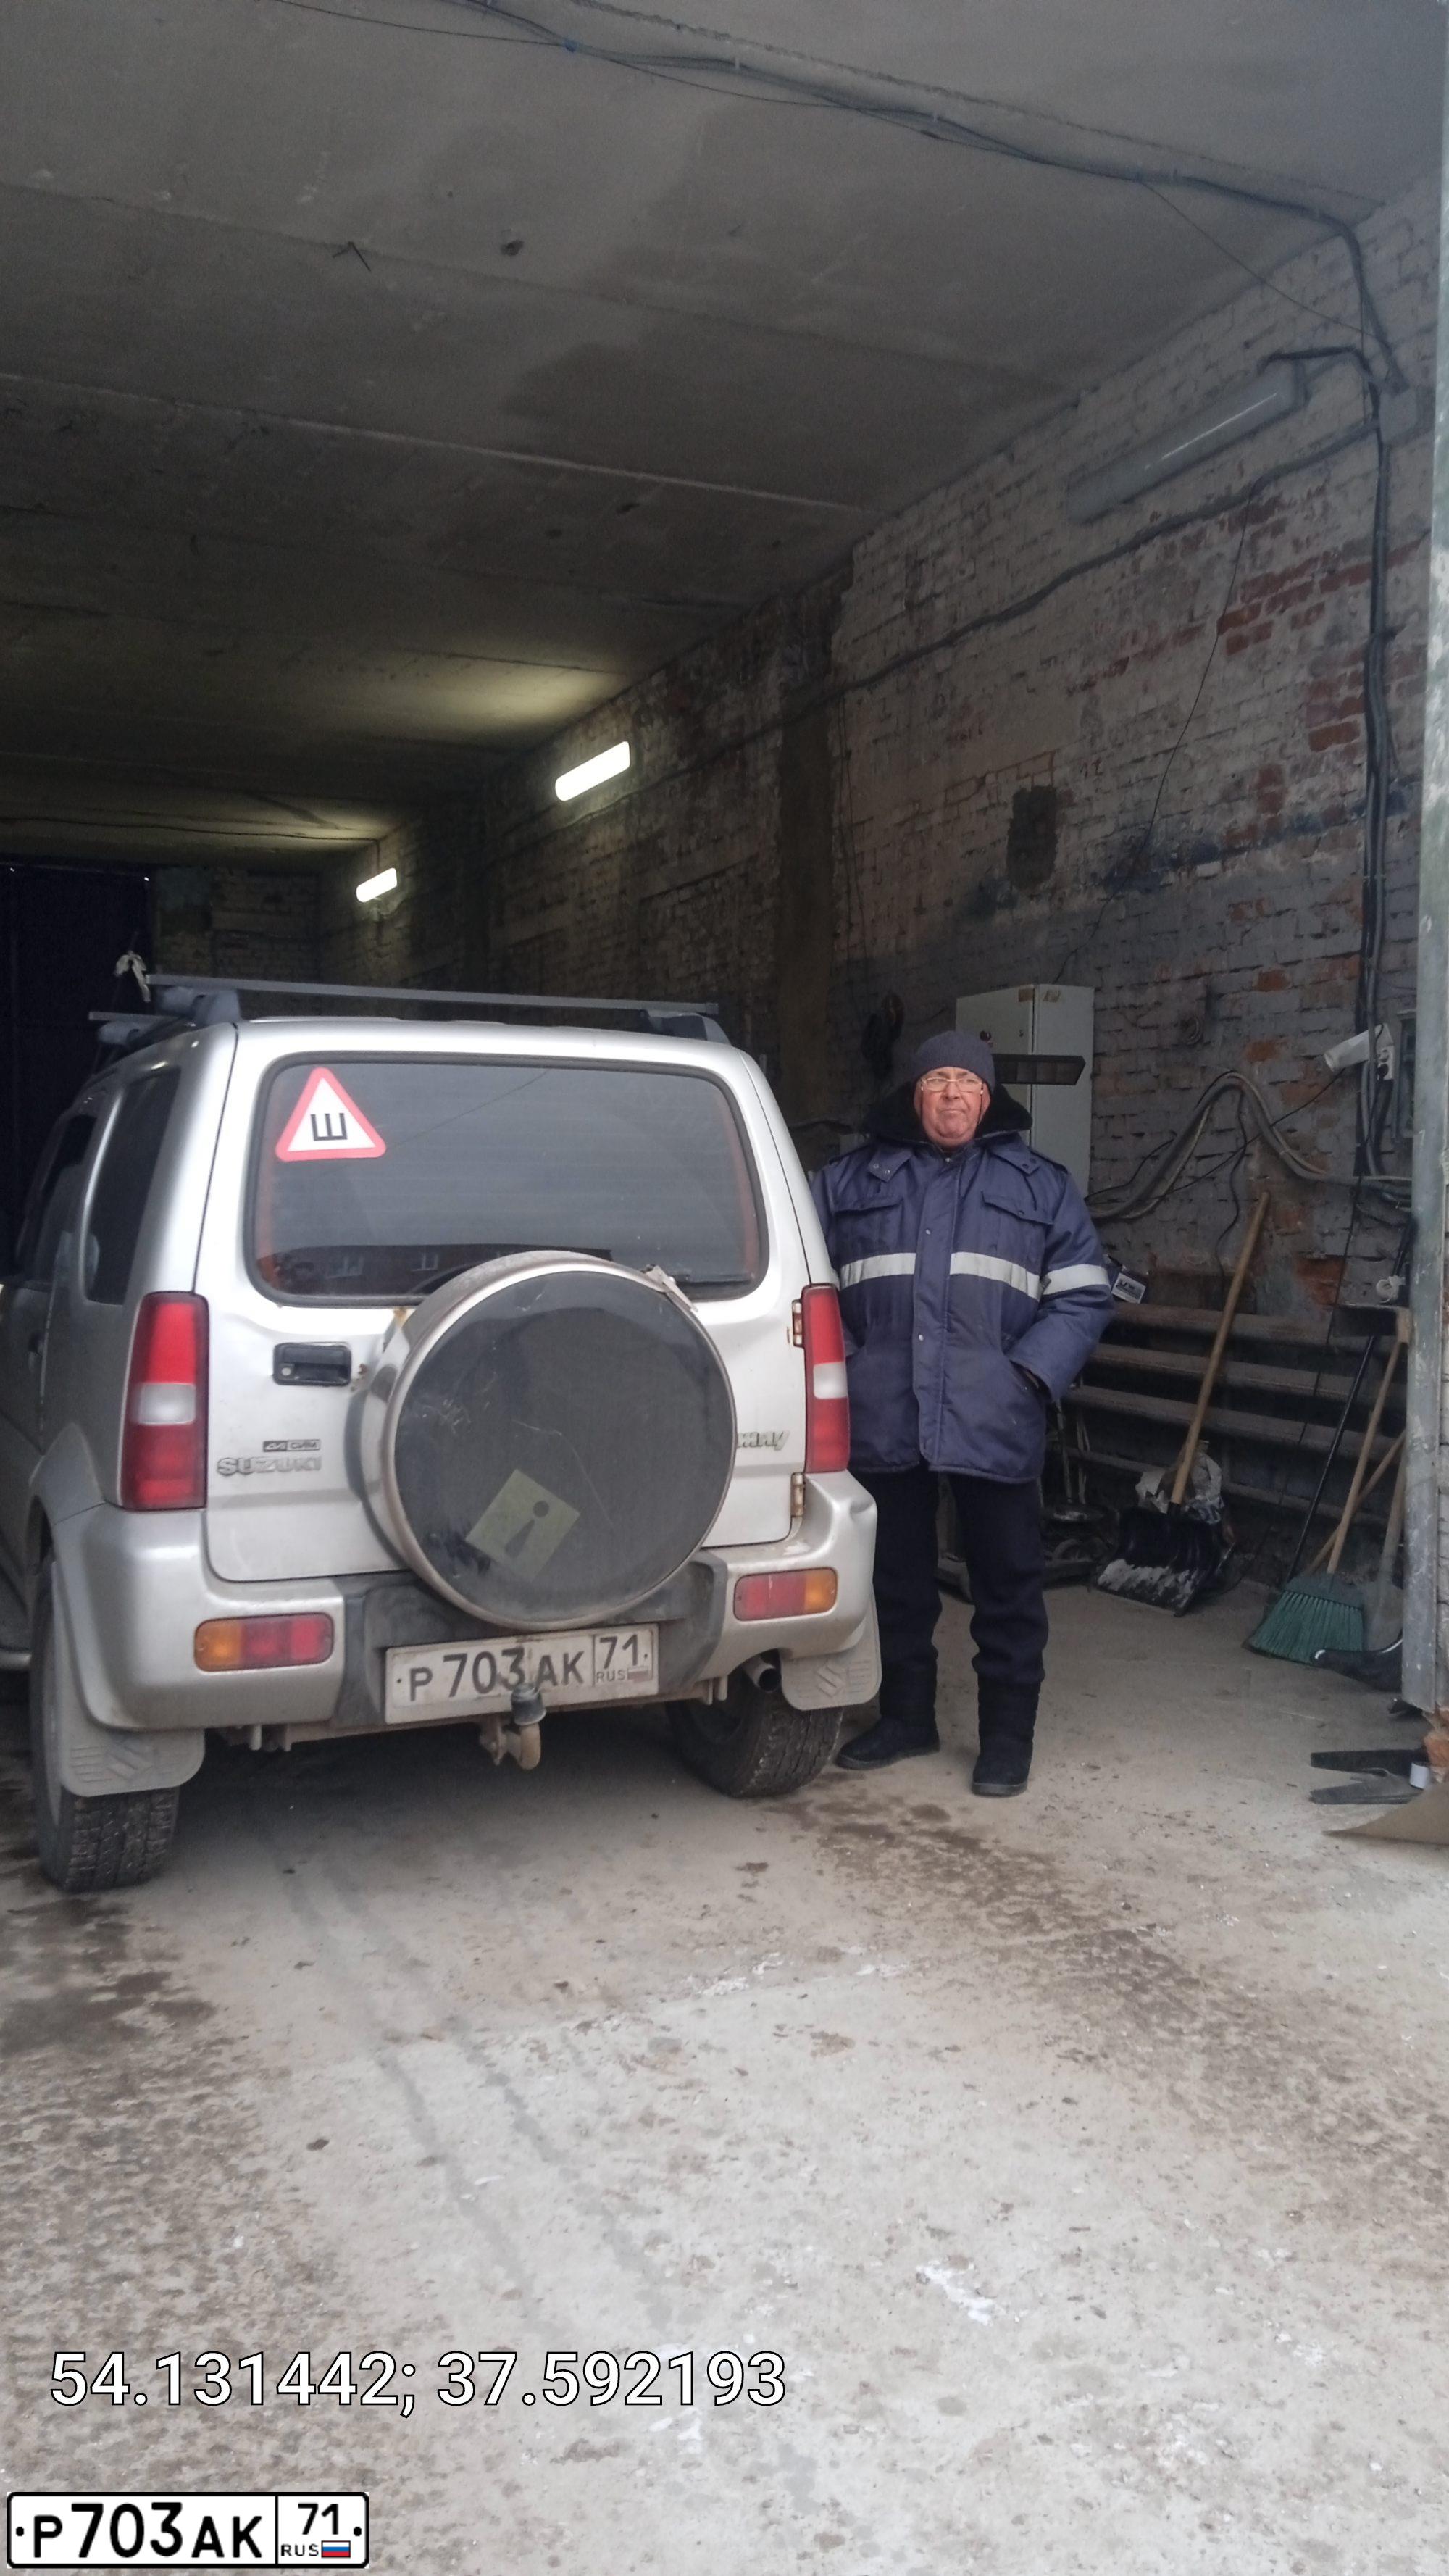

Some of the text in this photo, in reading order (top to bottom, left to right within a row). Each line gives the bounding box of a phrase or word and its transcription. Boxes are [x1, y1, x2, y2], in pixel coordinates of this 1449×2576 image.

[310, 1112, 348, 1141] Ш
[217, 1456, 322, 1477] SUZUKI
[599, 1633, 639, 1670] 71
[596, 1669, 626, 1683] RUS
